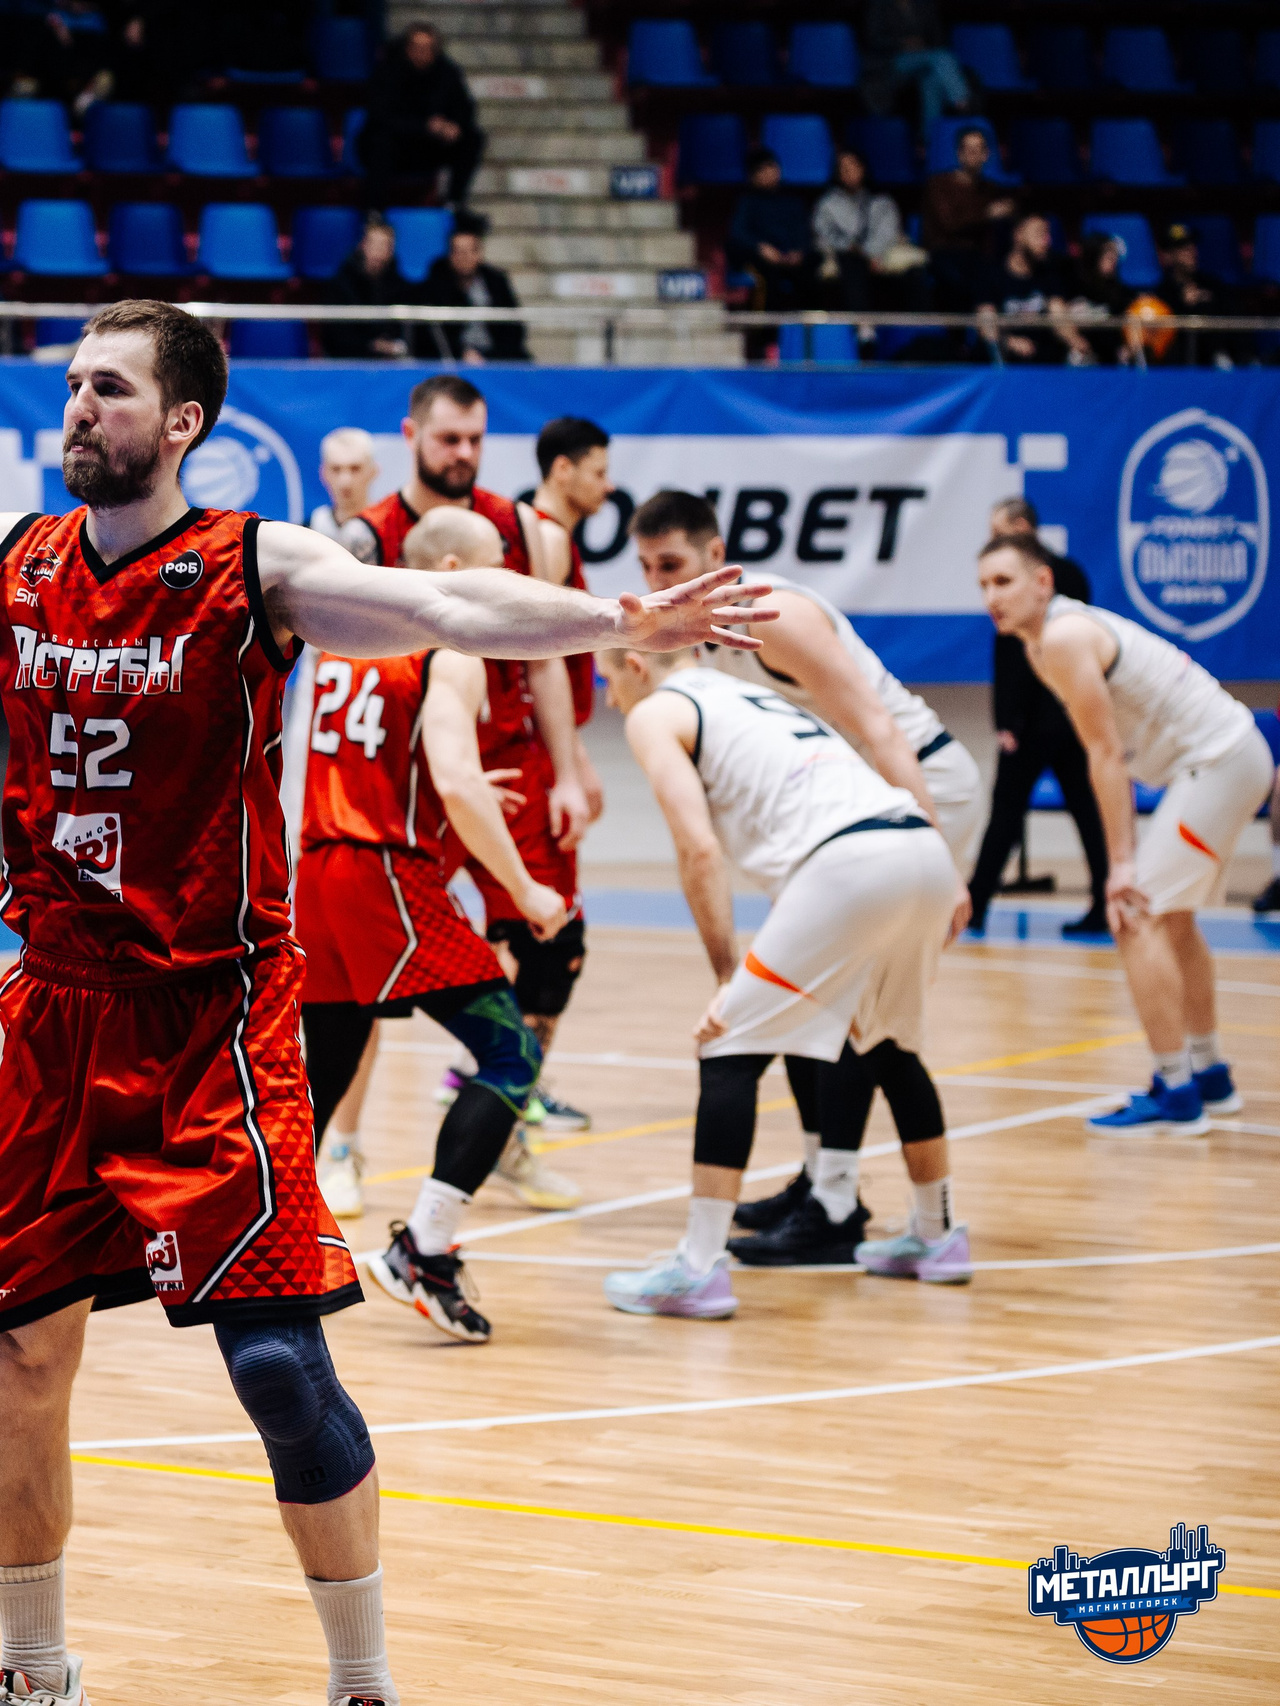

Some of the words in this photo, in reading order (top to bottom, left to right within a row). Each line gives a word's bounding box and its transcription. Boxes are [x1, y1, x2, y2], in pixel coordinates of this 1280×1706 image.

[517, 486, 928, 562] OBET
[165, 561, 198, 574] РФБ
[10, 624, 194, 696] ЯСТРЕБЫ
[41, 632, 143, 648] ЧБОКСАРЫ
[311, 660, 387, 759] 24
[49, 712, 133, 789] 52
